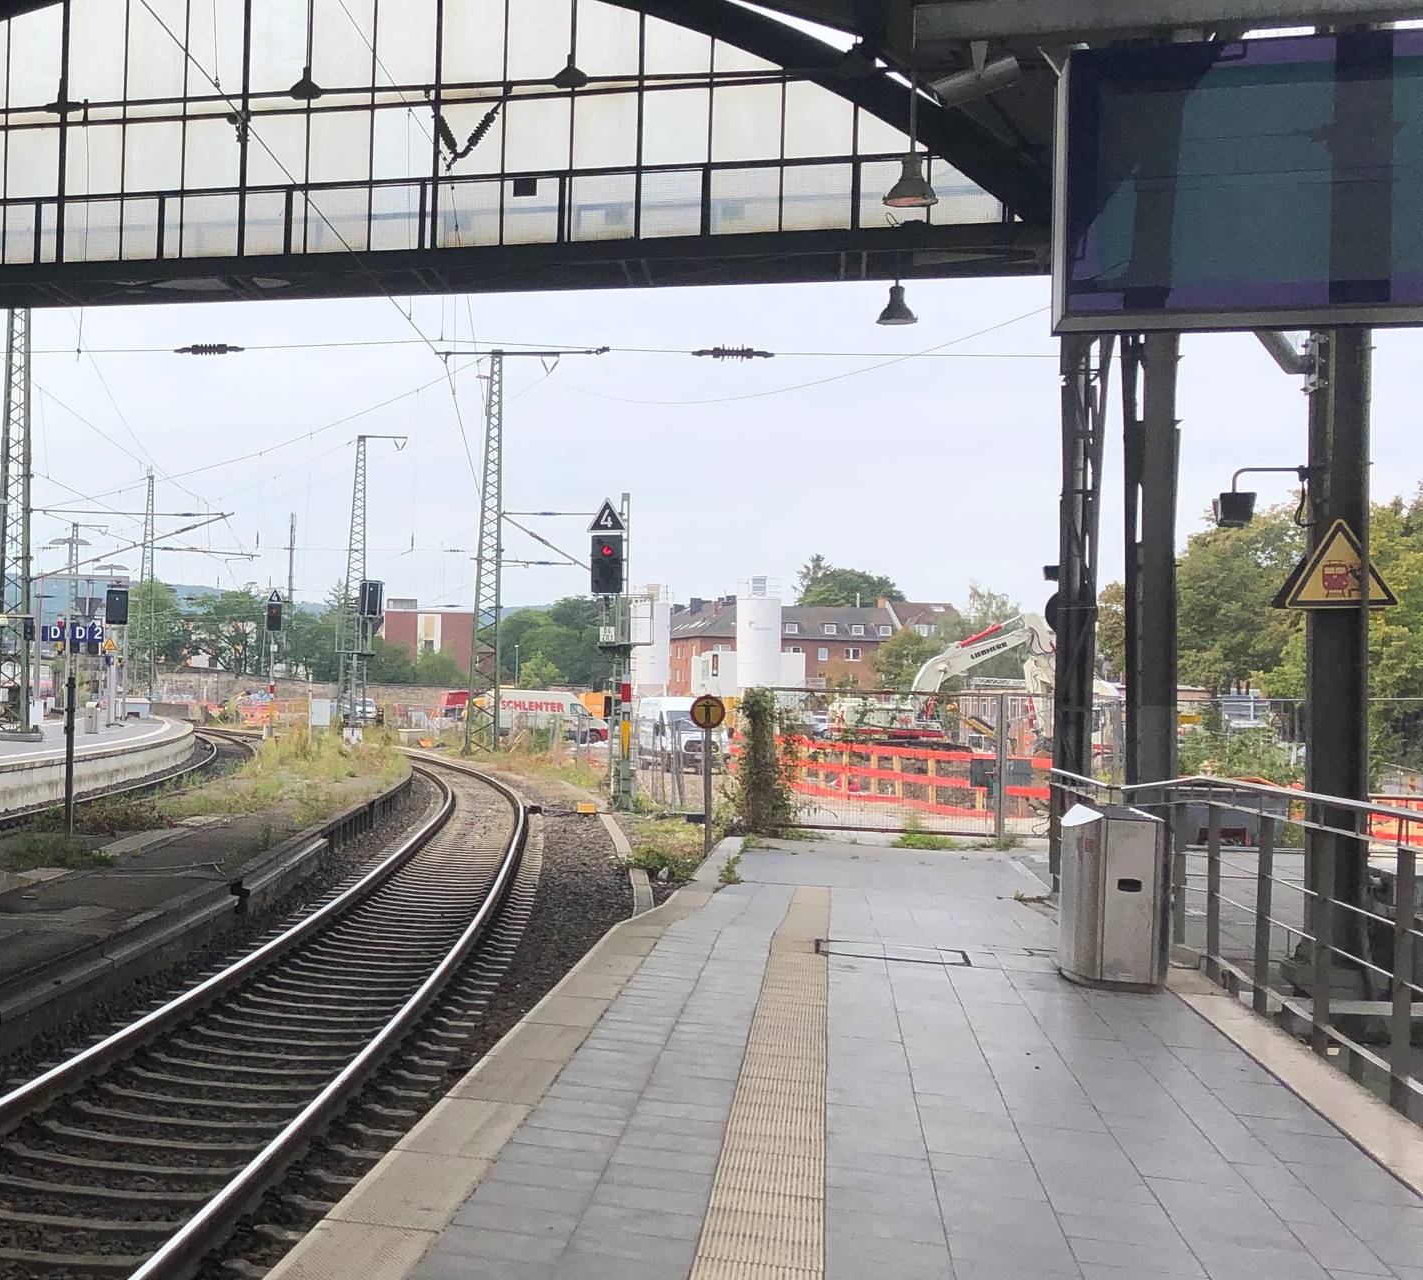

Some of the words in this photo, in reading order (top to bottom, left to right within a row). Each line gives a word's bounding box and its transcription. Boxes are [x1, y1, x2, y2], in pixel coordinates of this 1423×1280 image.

[600, 509, 613, 528] 4
[51, 626, 60, 639] D
[75, 626, 85, 639] D
[94, 627, 102, 640] 2
[501, 699, 564, 713] SCHLENTER
